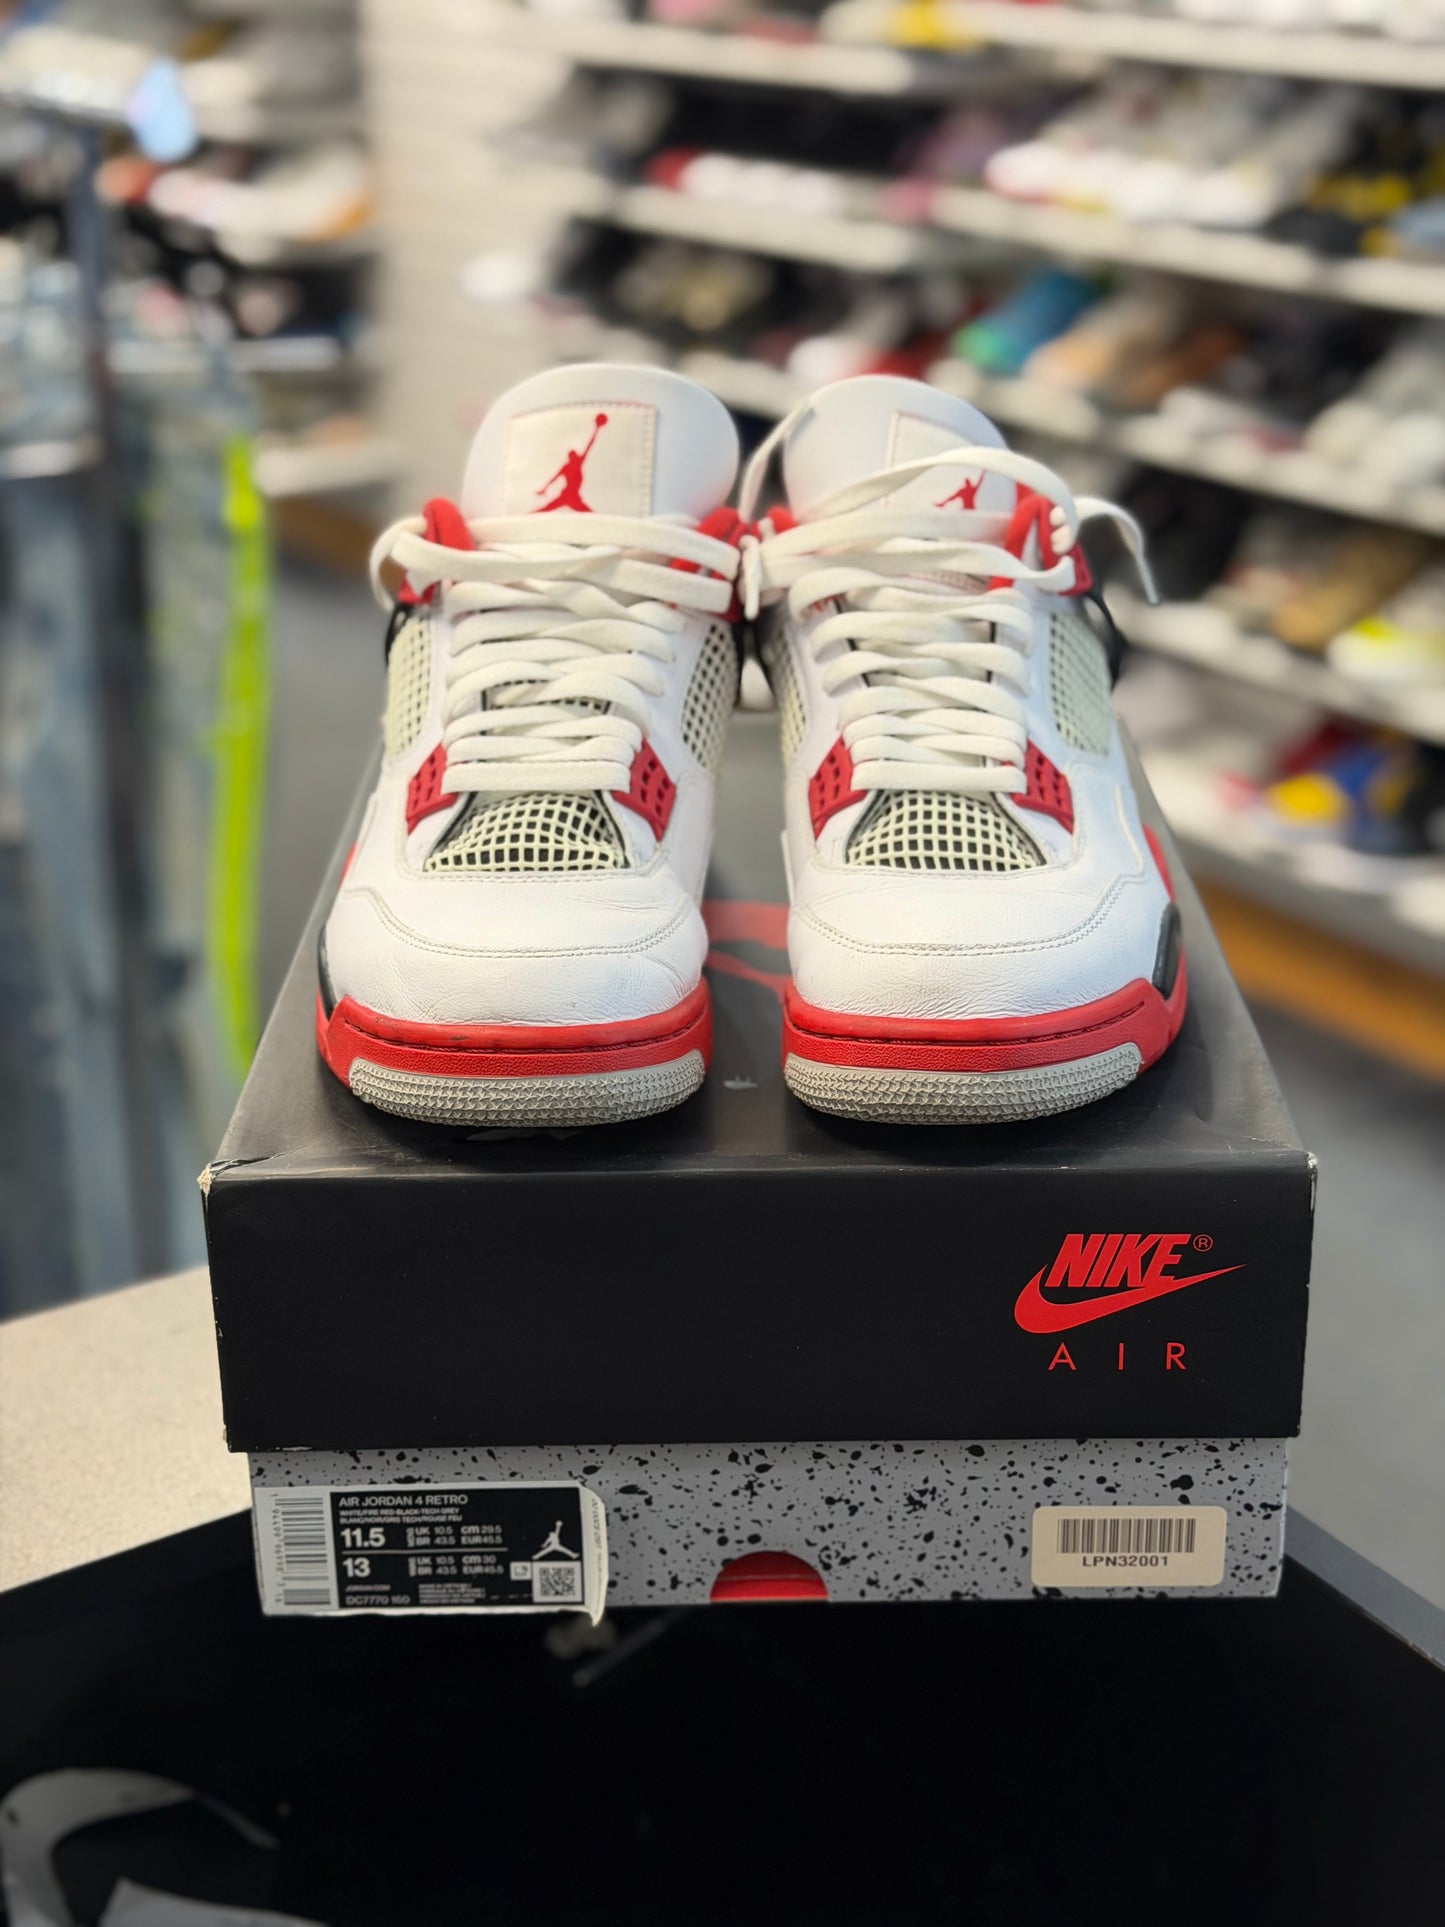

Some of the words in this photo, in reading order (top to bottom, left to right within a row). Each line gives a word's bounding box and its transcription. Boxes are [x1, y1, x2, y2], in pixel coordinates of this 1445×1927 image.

[1044, 1233, 1191, 1288] NIKE
[1048, 1342, 1186, 1371] AIR
[339, 1496, 360, 1508] AIR
[361, 1495, 412, 1507] JORDAN
[415, 1495, 424, 1506] 4
[425, 1494, 468, 1505] RETRO
[339, 1508, 379, 1517] WHITE/FIRE
[380, 1507, 439, 1516] RED-BLACK-TECH
[440, 1507, 460, 1515] GREY
[402, 1515, 447, 1523] TECH/ROUGE
[448, 1514, 463, 1522] FEU
[415, 1526, 430, 1536] UK
[434, 1526, 453, 1535] 10.5
[460, 1525, 480, 1534] cm
[481, 1525, 502, 1534] 29.5
[340, 1527, 386, 1548] 11.5
[415, 1536, 431, 1546] BR
[434, 1536, 456, 1545] 43.5
[417, 1556, 432, 1565] UK
[435, 1556, 455, 1565] 10.5
[462, 1555, 482, 1564] cm
[483, 1555, 497, 1564] 30
[1082, 1555, 1169, 1567] LPN32001
[342, 1557, 371, 1578] 13
[417, 1566, 433, 1576] BR
[345, 1594, 389, 1605] DC7770
